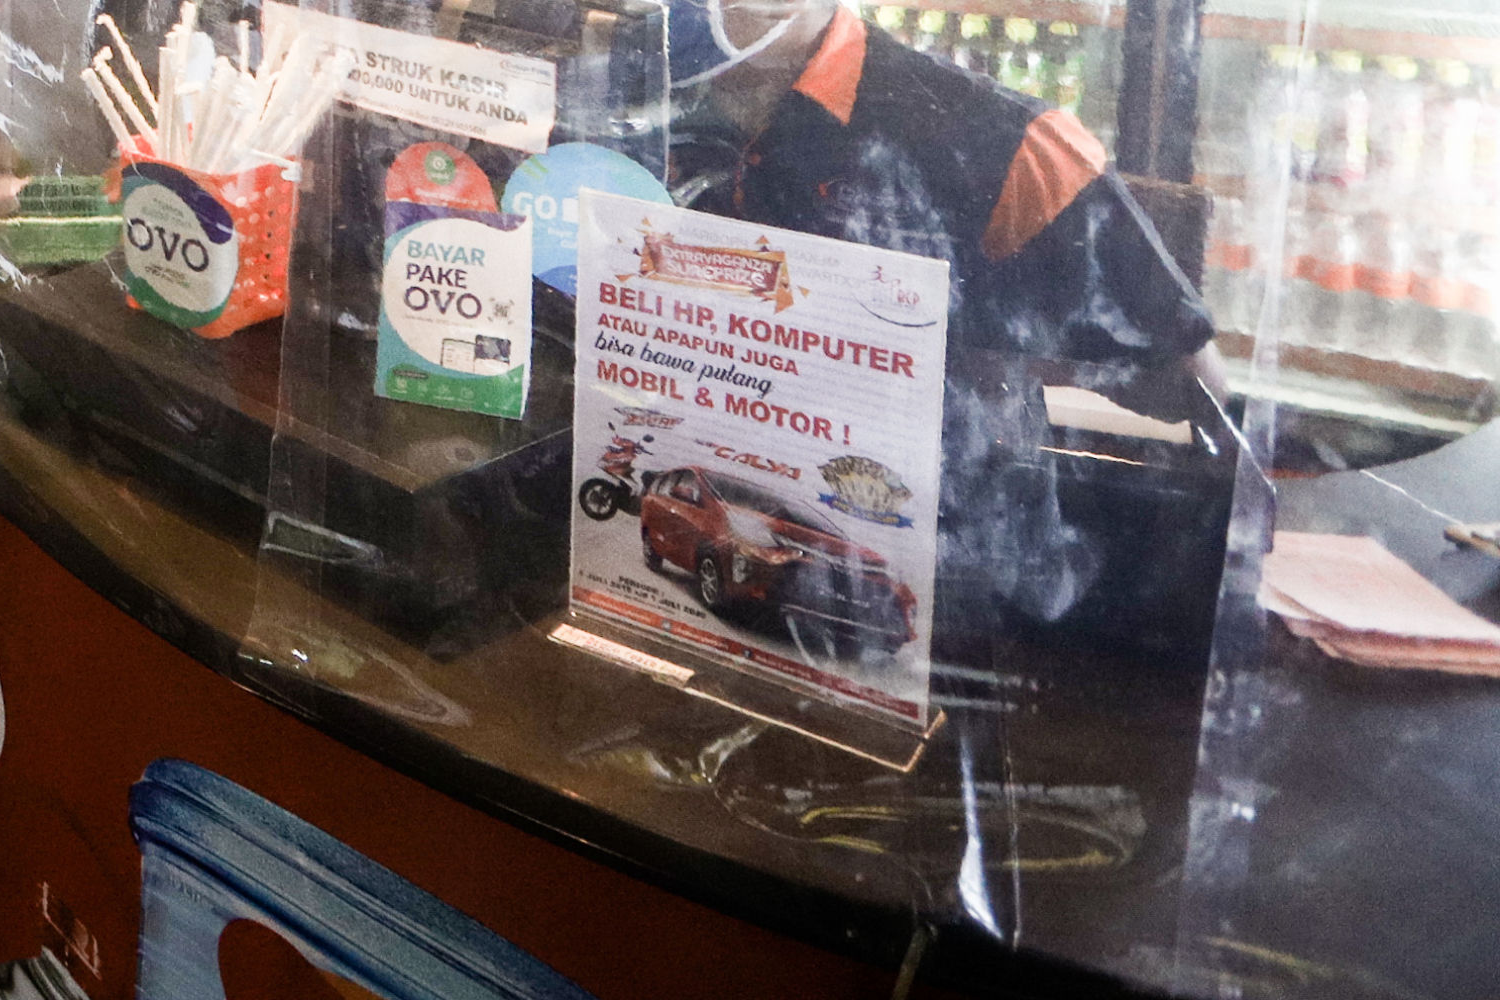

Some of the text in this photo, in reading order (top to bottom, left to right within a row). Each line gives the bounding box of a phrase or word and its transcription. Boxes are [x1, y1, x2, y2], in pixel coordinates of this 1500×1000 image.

[366, 51, 434, 83] STRUK
[440, 69, 509, 101] KASIR
[409, 83, 471, 112] UNTUK
[476, 100, 529, 127] ANDA
[128, 218, 209, 273] OVO
[407, 240, 486, 267] BAYAR
[661, 245, 773, 274] EXTRAVAGANZA
[406, 263, 469, 289] PAKE
[404, 286, 483, 319] OVO
[597, 313, 800, 376] ATAU APAPUN JUGA
[600, 282, 916, 379] BELI HP, KOMPUTER
[594, 331, 773, 398] bisa bawa pulang
[597, 359, 685, 401] MOBIL
[695, 386, 714, 409] &
[725, 393, 834, 443] MOTOR
